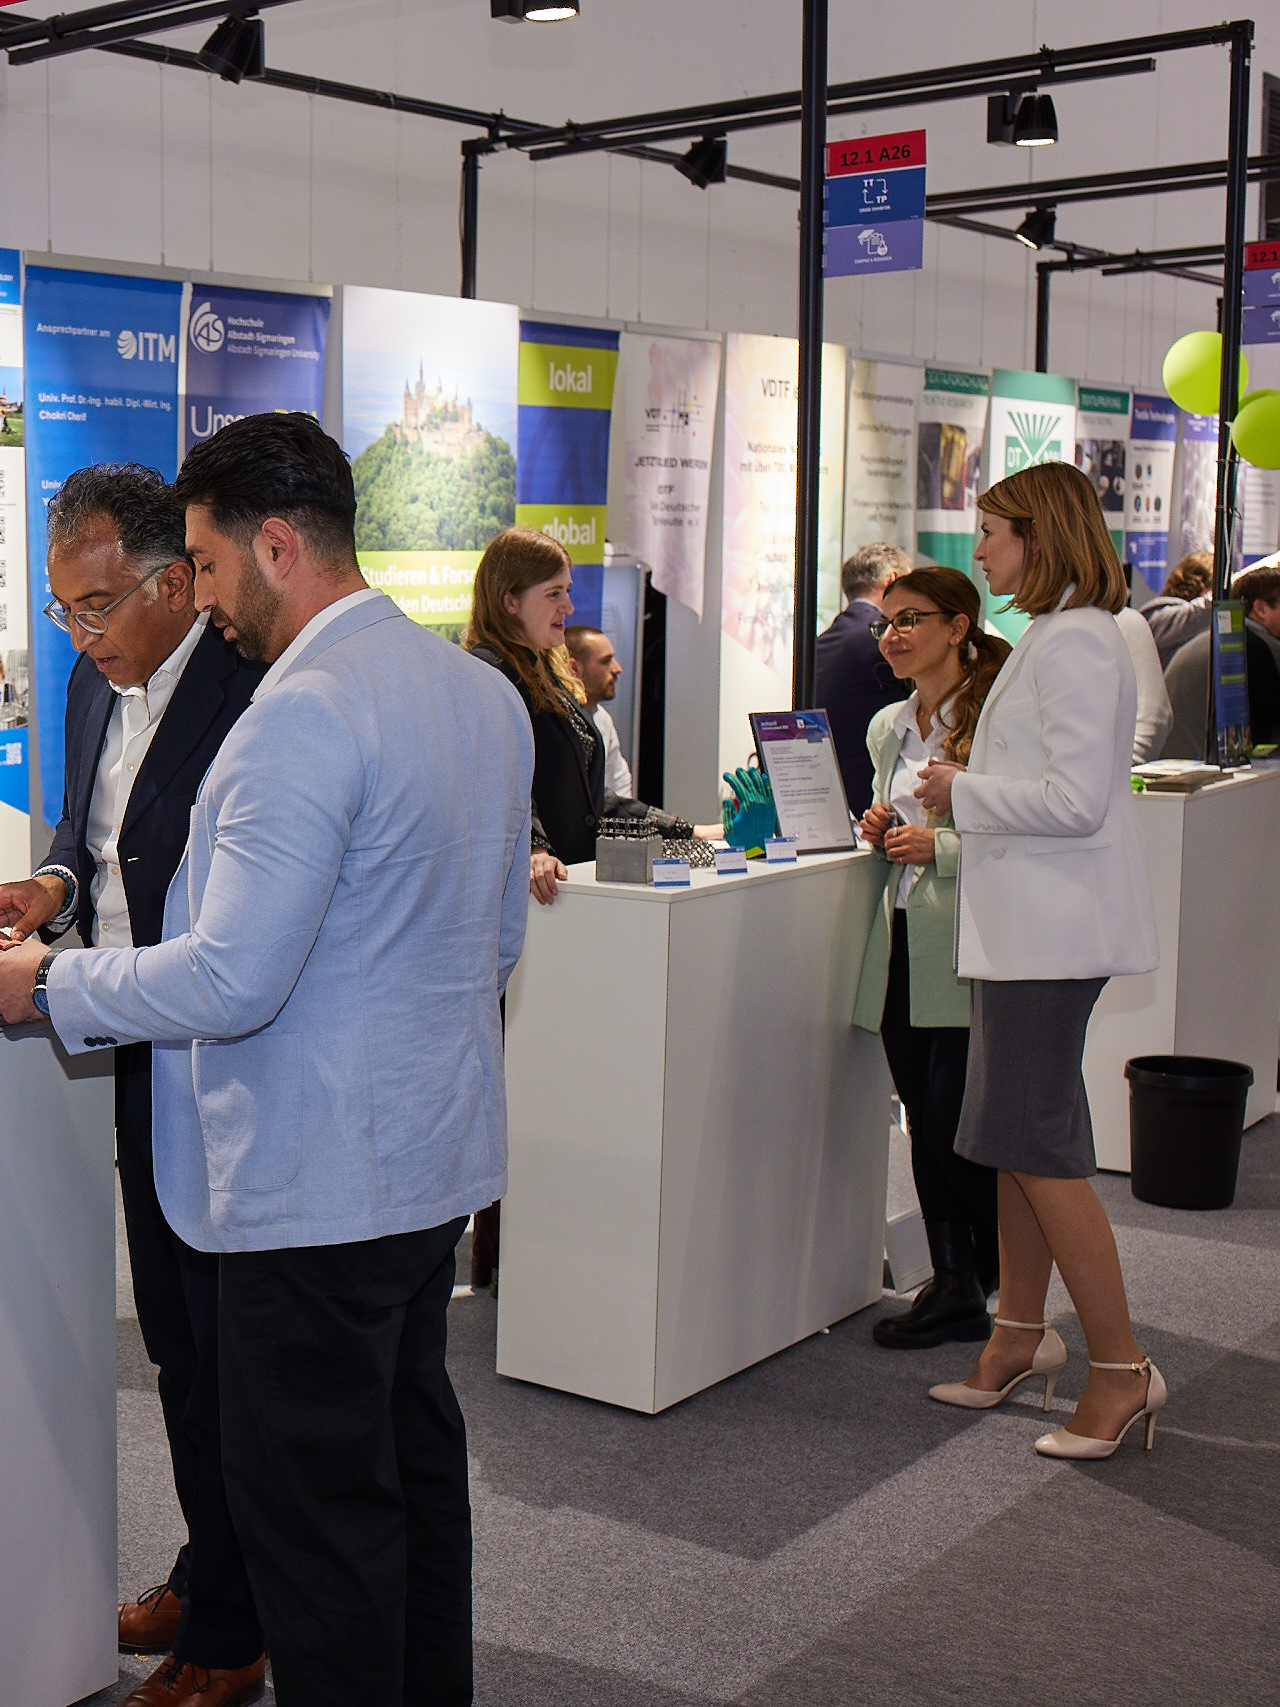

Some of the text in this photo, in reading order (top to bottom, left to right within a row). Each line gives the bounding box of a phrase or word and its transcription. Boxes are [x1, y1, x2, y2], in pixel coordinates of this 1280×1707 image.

[840, 144, 911, 167] 12.1 A26
[1252, 251, 1278, 263] 12.1
[138, 331, 176, 363] ITM
[549, 362, 592, 393] lokal
[361, 564, 427, 586] Studieren
[430, 565, 441, 586] &
